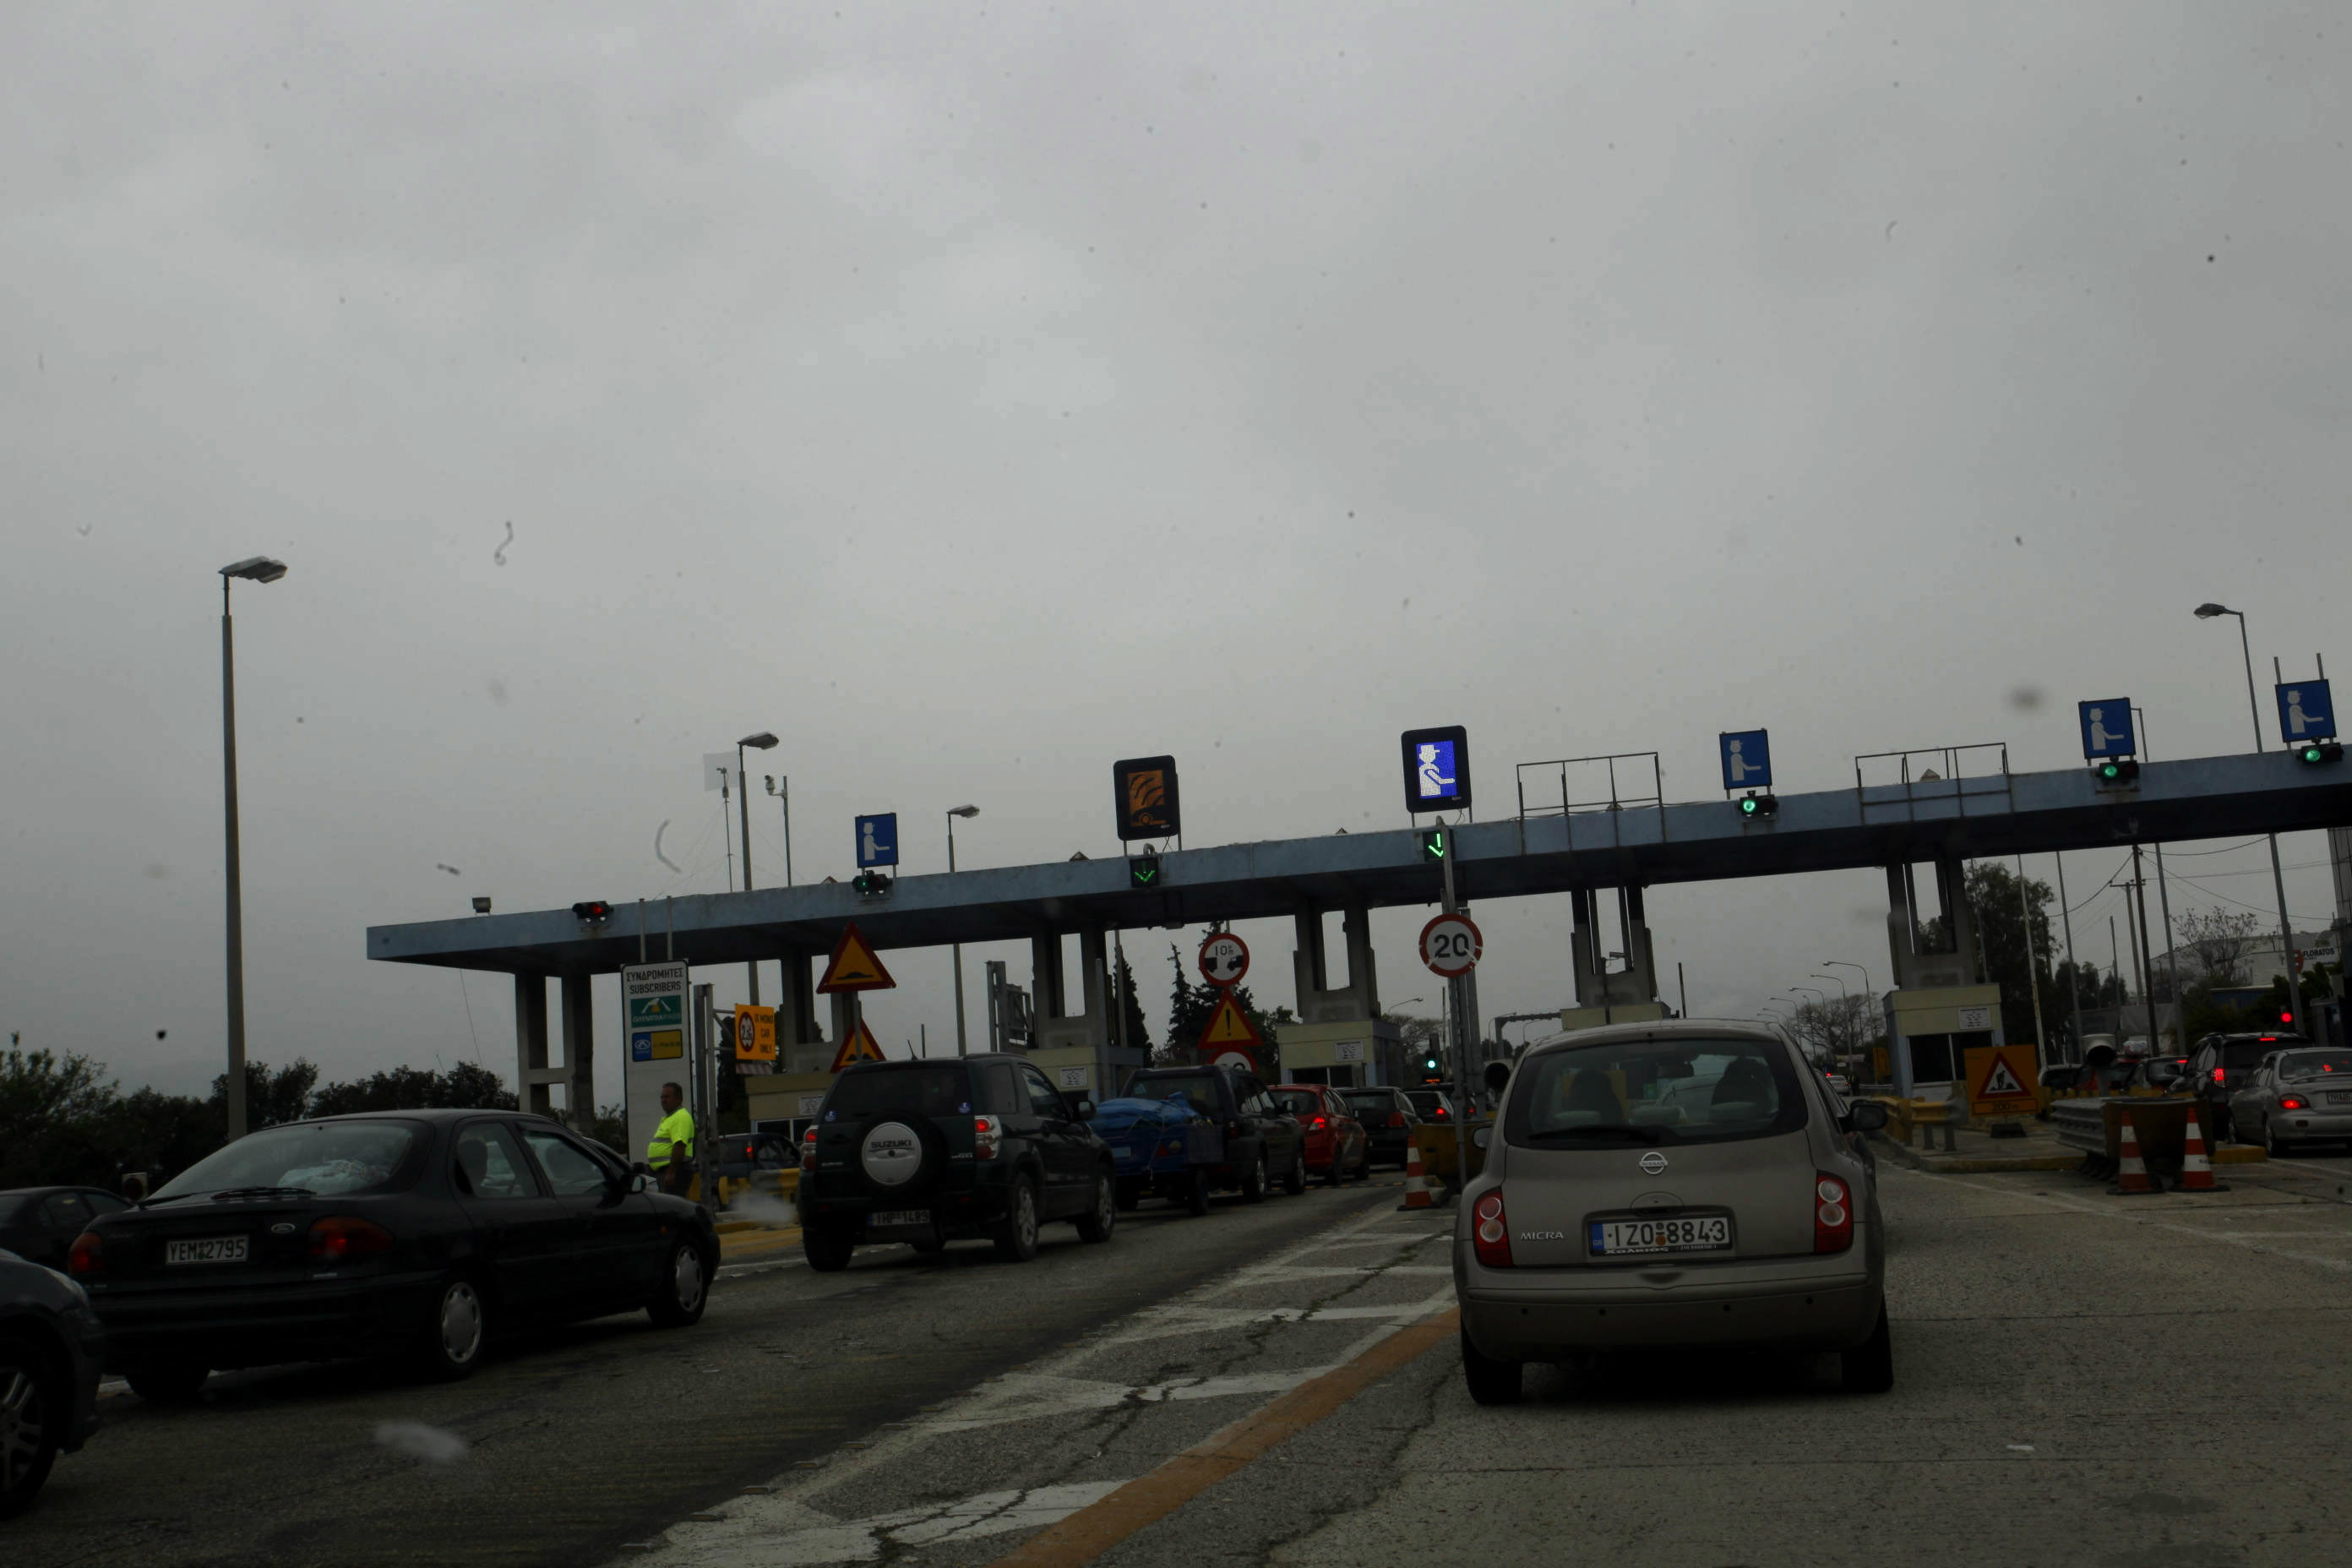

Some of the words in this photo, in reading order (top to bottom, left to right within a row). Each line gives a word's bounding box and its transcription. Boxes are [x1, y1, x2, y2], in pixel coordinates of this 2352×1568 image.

[1434, 933, 1470, 959] 20
[2303, 947, 2335, 958] FLORATOS
[627, 967, 683, 982] ΣΥΝΔΡΟΜΗΤΕΣ
[629, 981, 682, 994] SUBSCRIBERS
[870, 1139, 912, 1149] SUZUKI
[1521, 1231, 1565, 1241] MICRA
